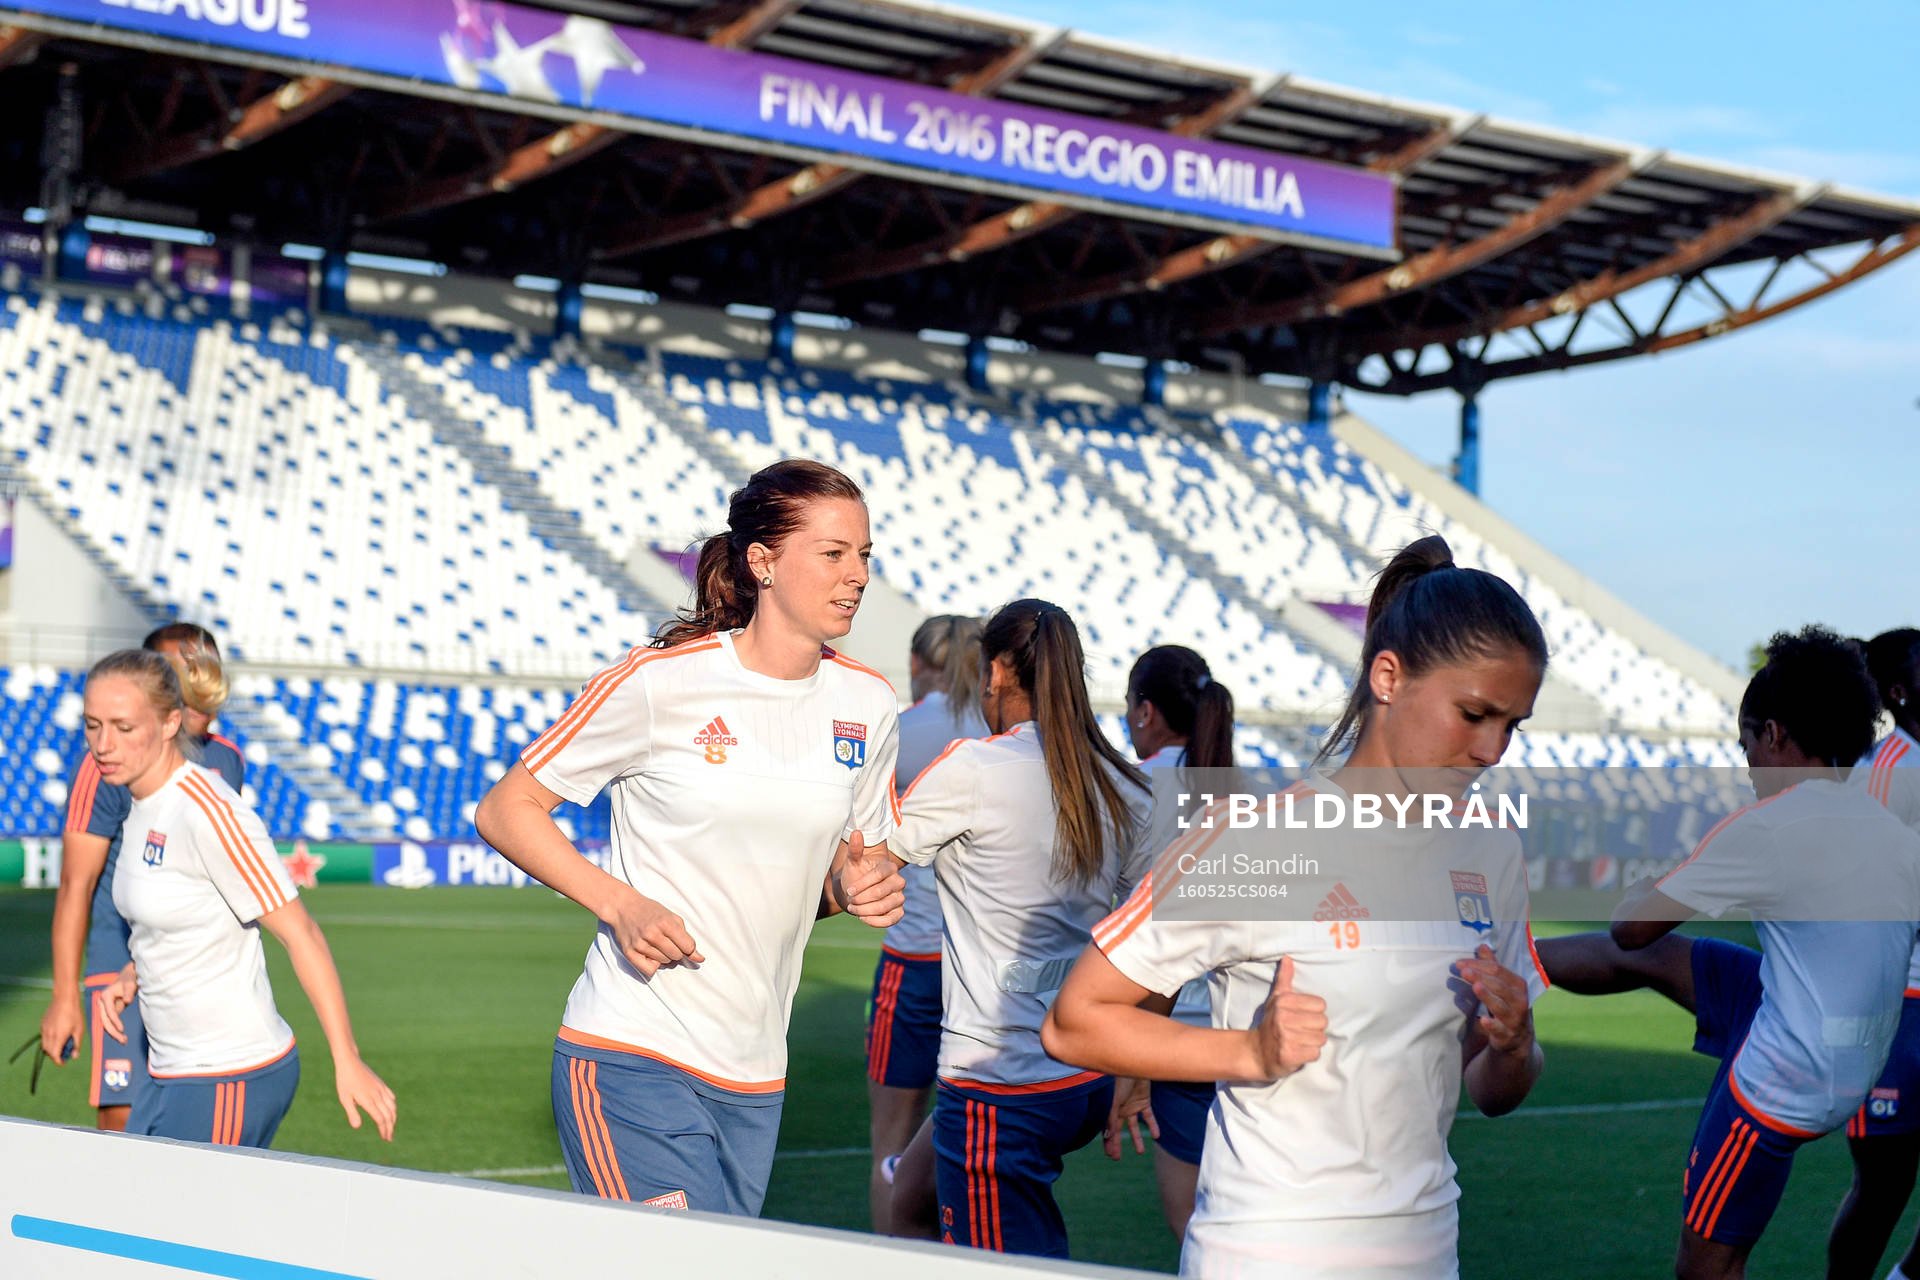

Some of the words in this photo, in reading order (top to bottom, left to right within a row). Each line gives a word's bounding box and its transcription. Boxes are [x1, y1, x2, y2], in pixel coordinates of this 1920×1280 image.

[760, 73, 897, 144] FINAL
[904, 102, 996, 161] 2016
[1002, 118, 1167, 192] REGGIO
[1173, 149, 1304, 219] EMILIA
[693, 734, 738, 746] adidas
[704, 745, 727, 764] 8
[1313, 906, 1370, 922] adidas
[1329, 921, 1360, 950] 19
